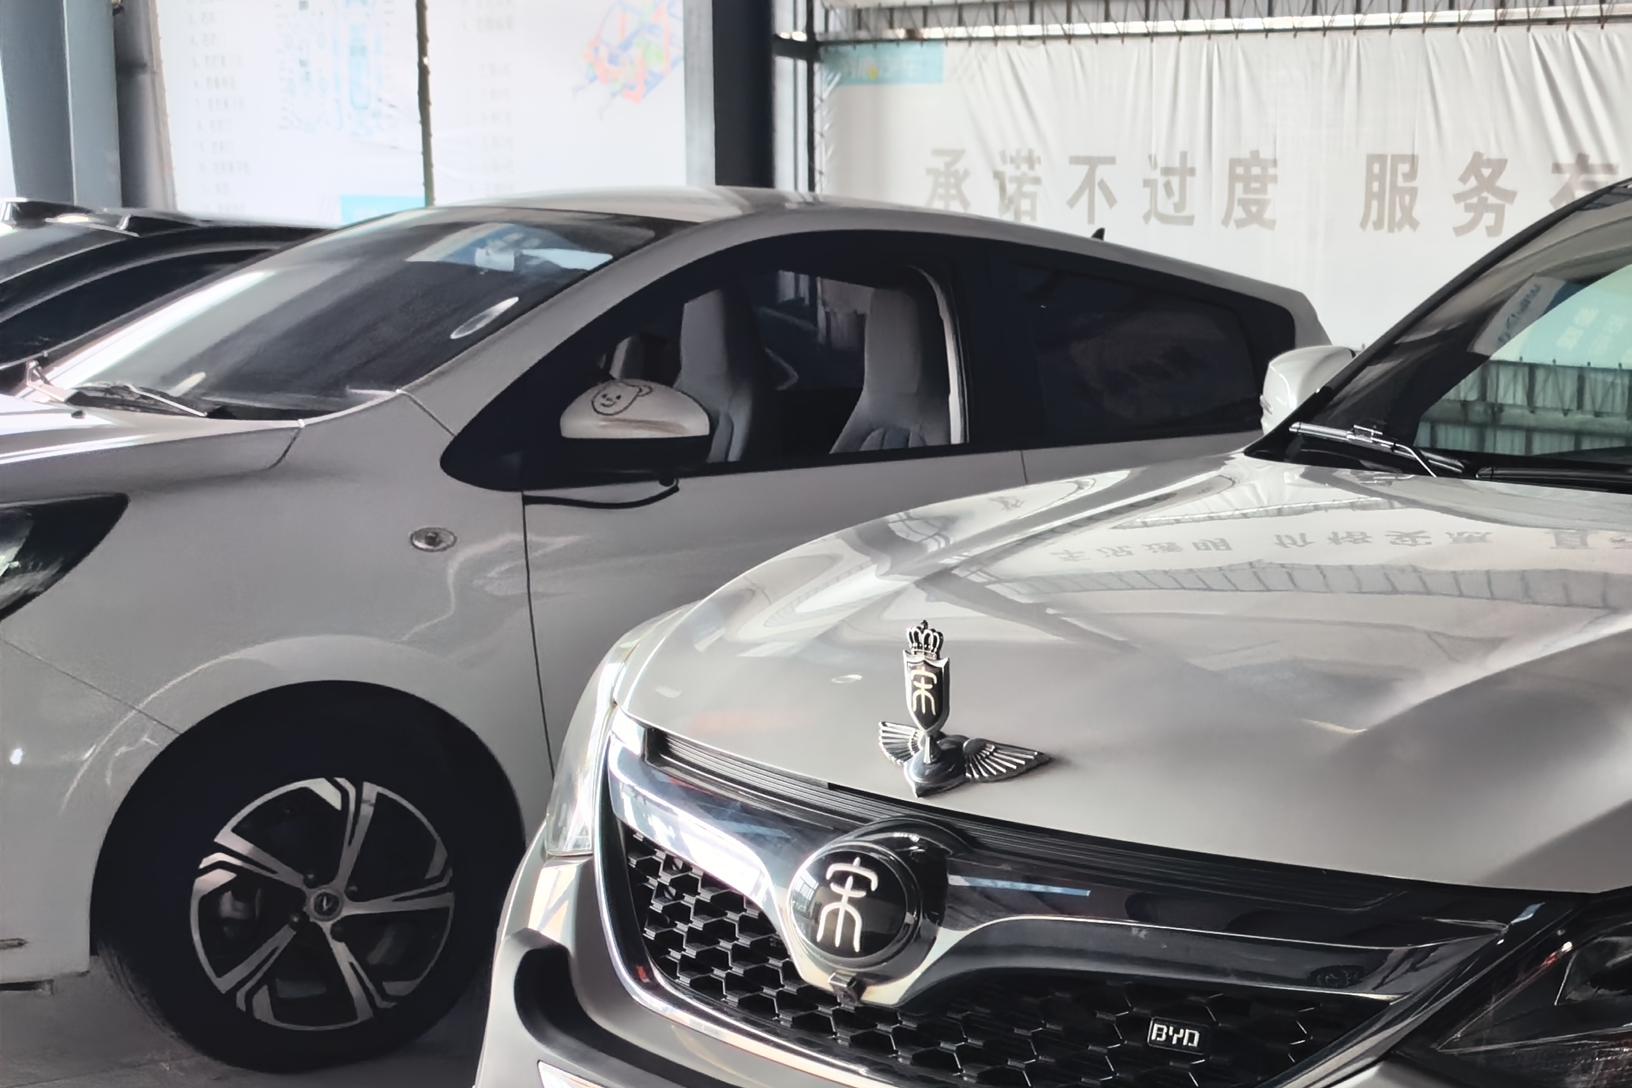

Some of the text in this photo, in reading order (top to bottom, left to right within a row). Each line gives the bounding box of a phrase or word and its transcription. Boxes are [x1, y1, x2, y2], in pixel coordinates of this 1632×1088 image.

[924, 147, 1279, 231] 承诺不过度
[815, 857, 879, 953] 宋
[1150, 1023, 1201, 1047] BYD
